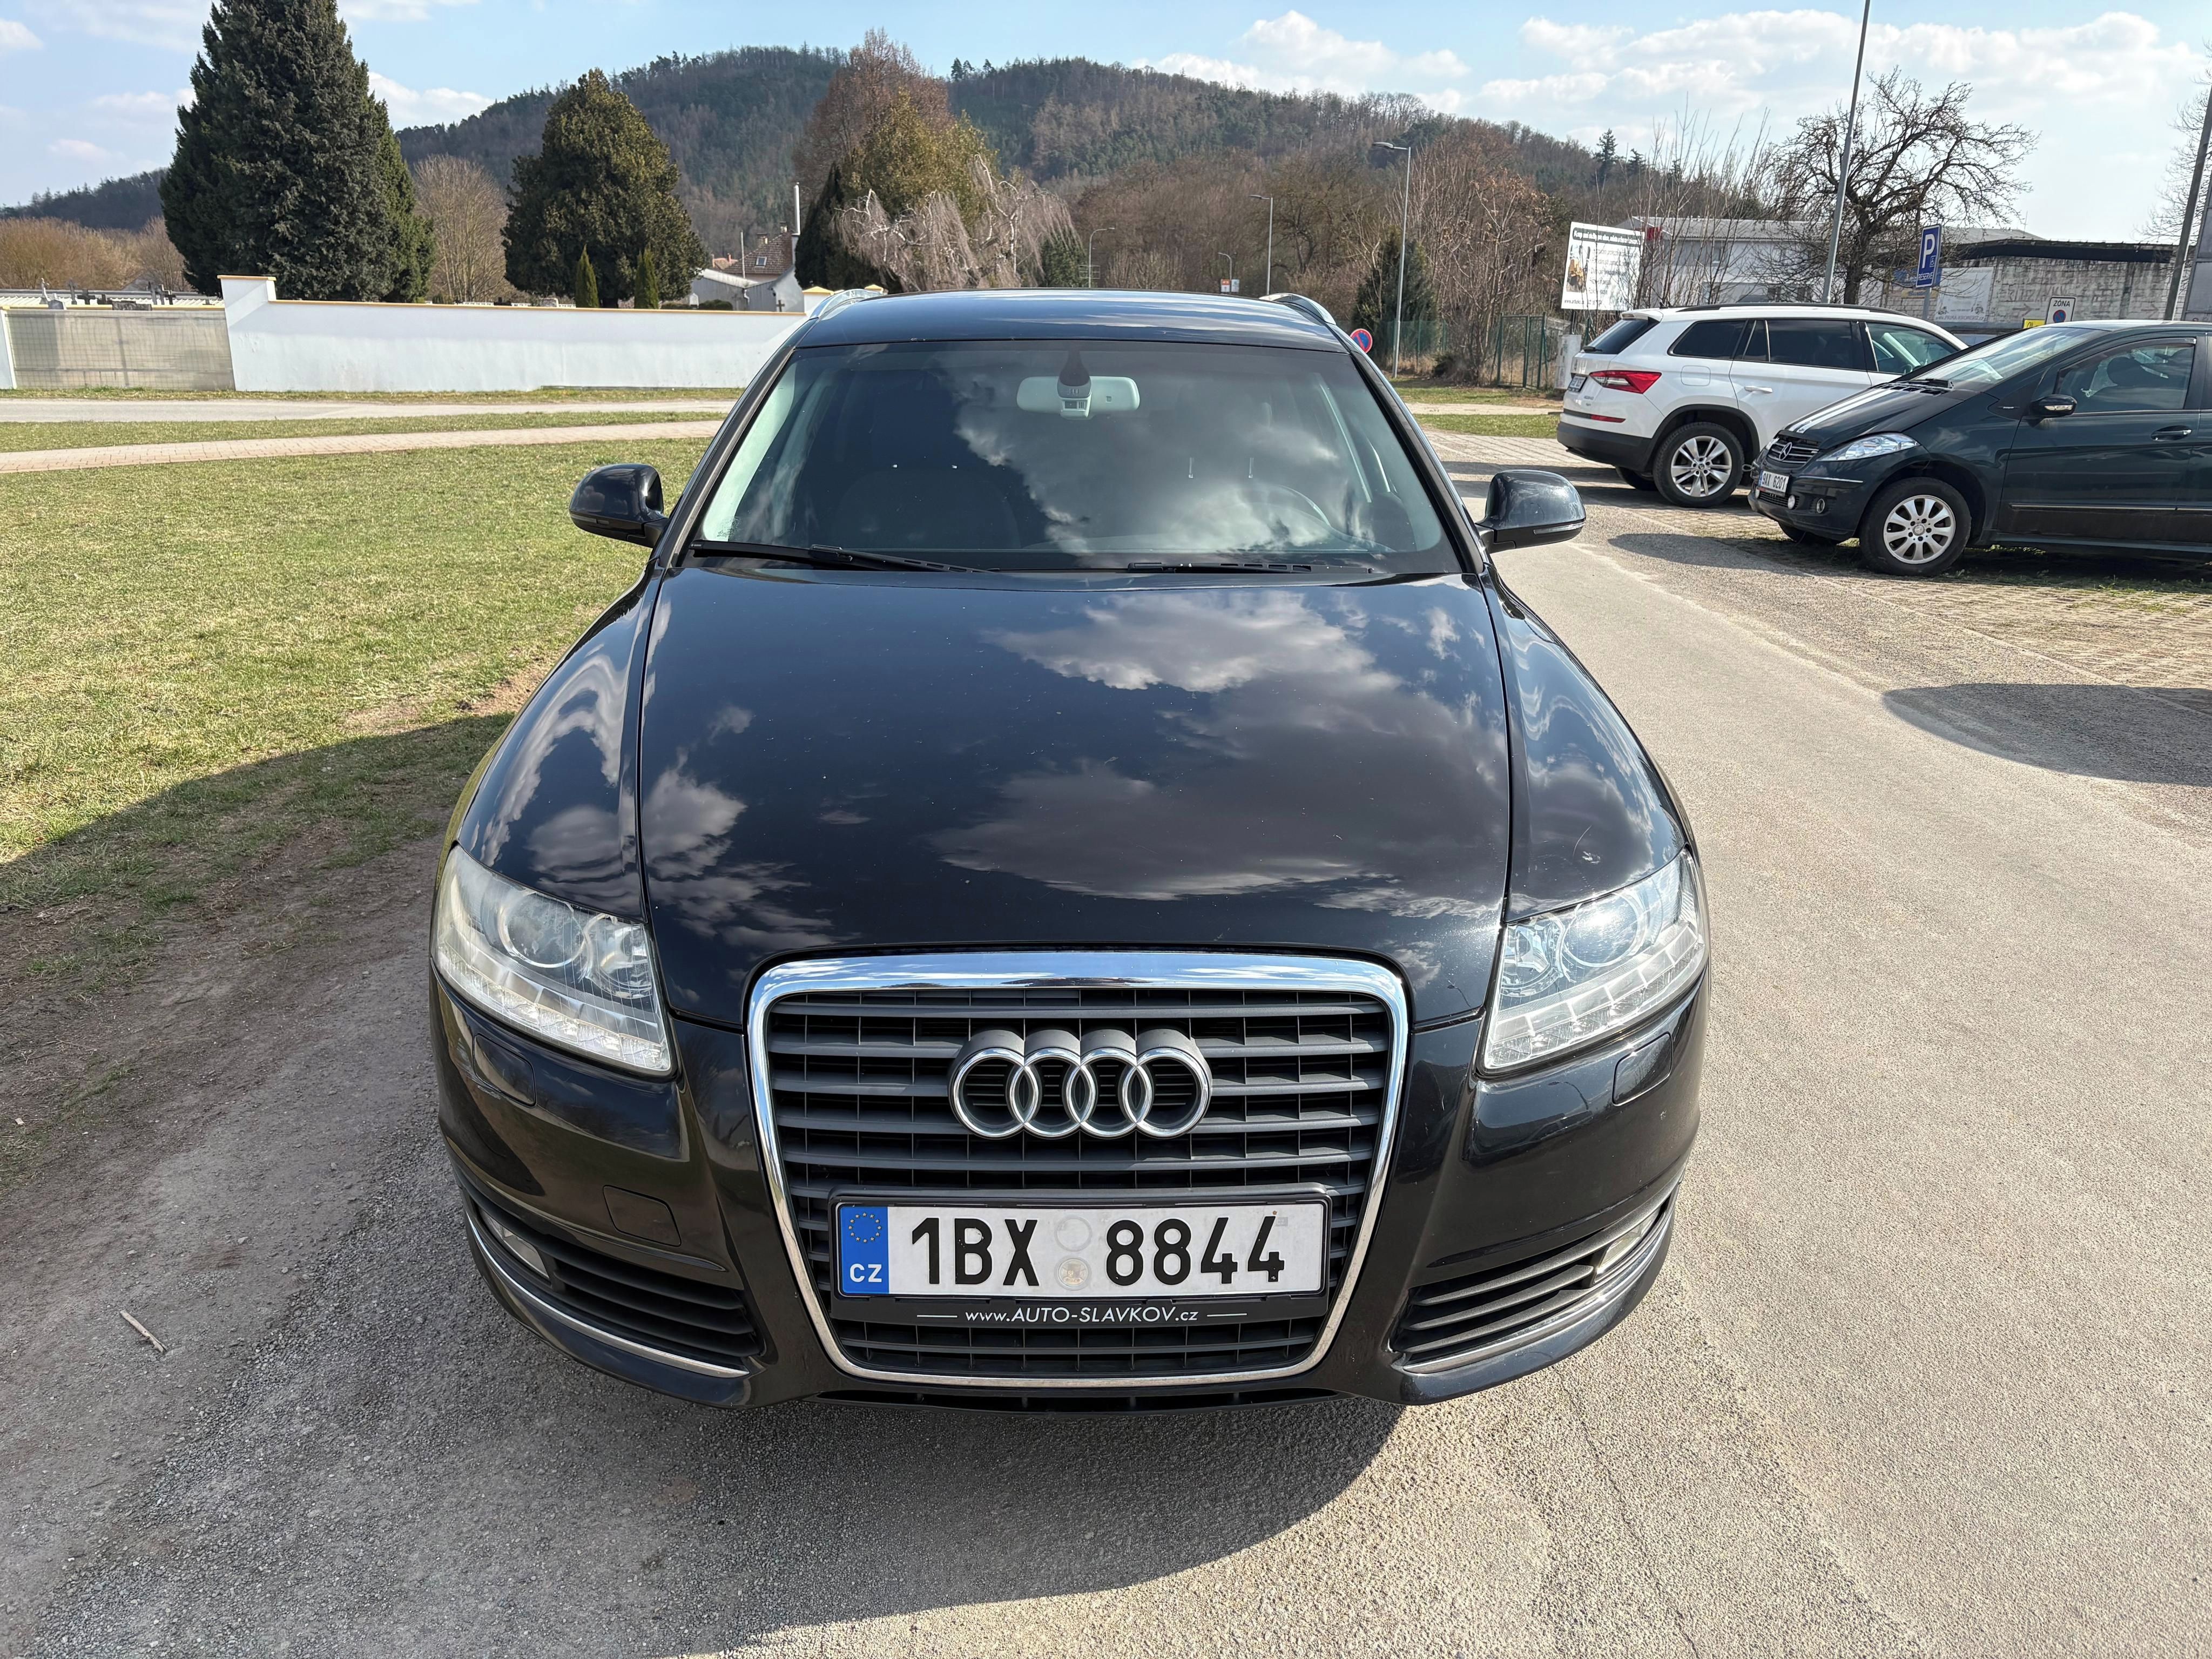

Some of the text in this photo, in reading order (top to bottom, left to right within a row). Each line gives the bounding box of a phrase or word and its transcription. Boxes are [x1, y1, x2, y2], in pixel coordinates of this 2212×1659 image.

[1921, 233, 1936, 269] P
[2053, 299, 2071, 307] ZÓNA
[1762, 473, 1772, 486] 9AX
[1773, 476, 1786, 490] 6201
[912, 1216, 1285, 1286] 1BX 8844
[849, 1263, 882, 1283] CZ
[965, 1306, 1199, 1323] www.AUTO-SLAVKOV.cz
